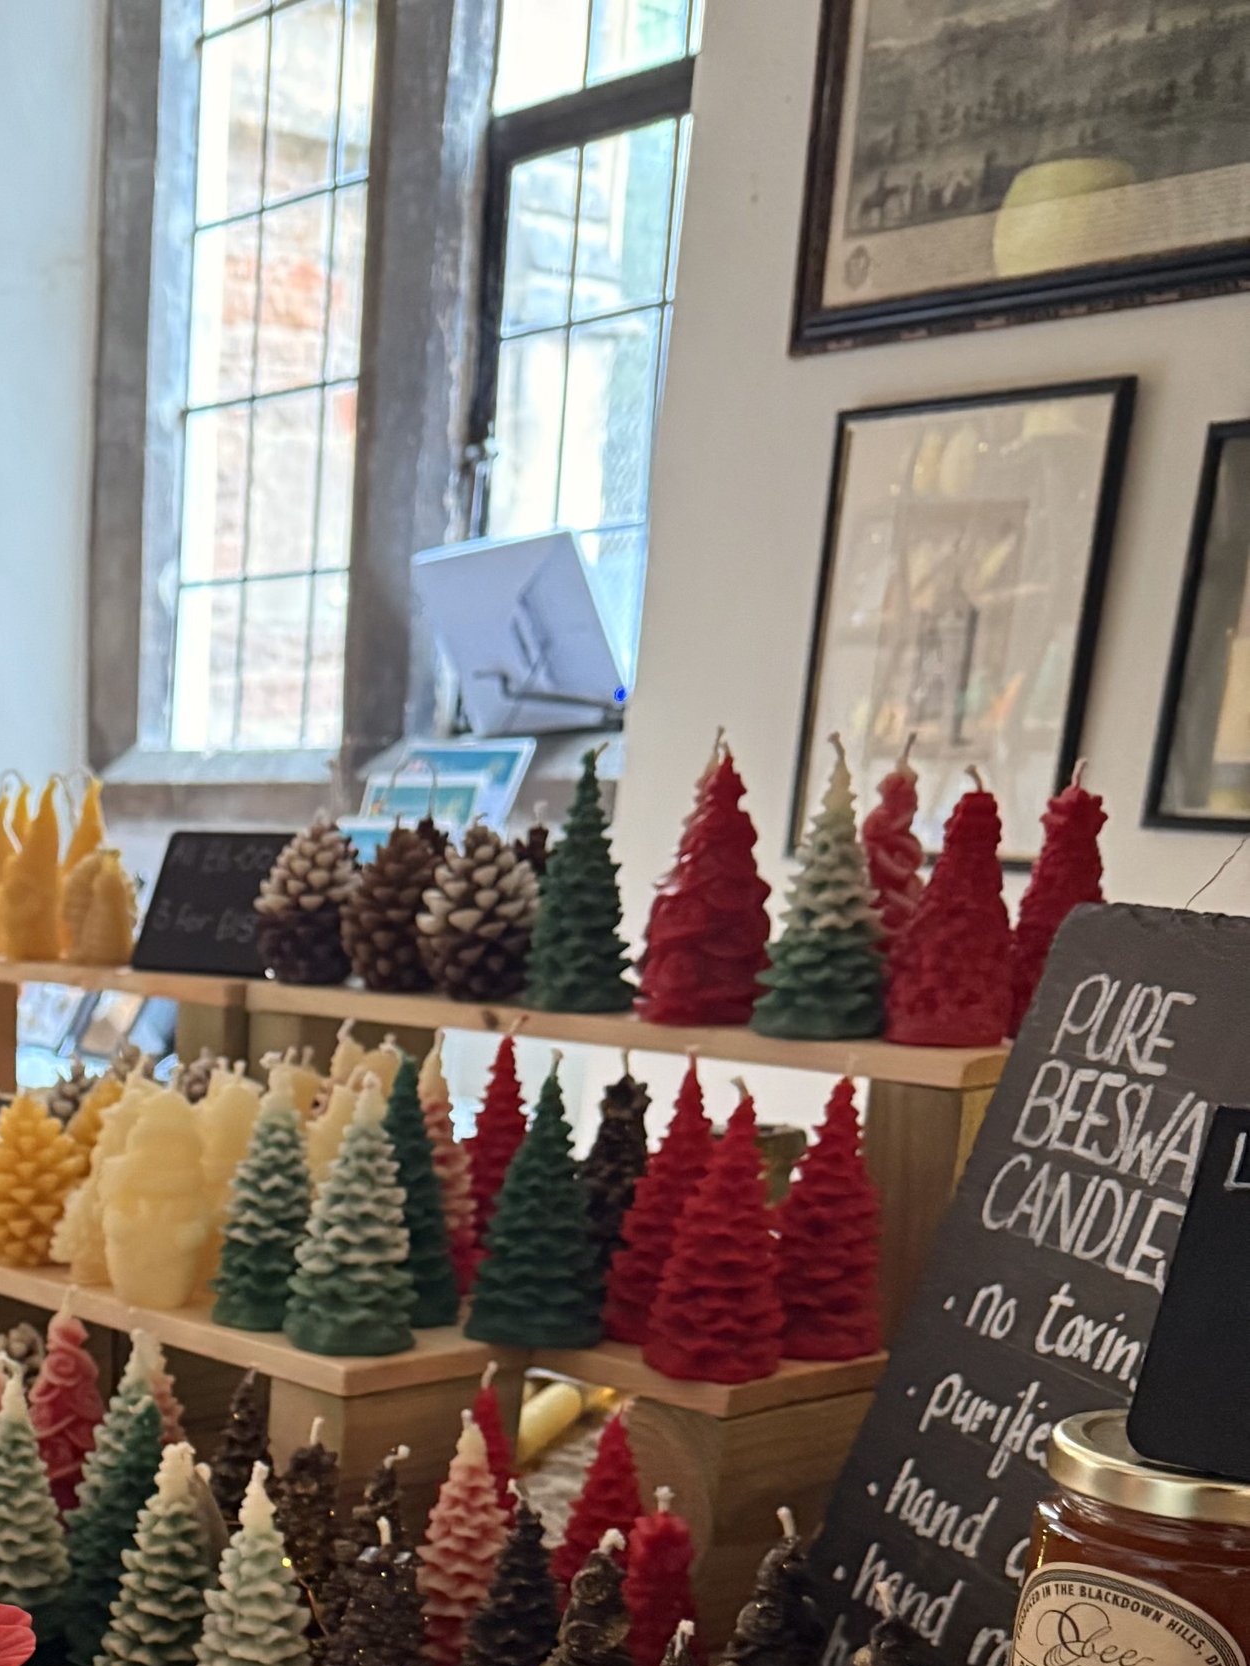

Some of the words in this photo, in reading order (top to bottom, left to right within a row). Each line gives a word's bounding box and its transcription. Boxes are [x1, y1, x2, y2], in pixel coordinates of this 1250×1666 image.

[1051, 972, 1197, 1077] PURE
[1013, 1059, 1208, 1197] BEESWA
[981, 1153, 1187, 1295] CANDLE
[964, 1283, 1016, 1341] no
[918, 1372, 1050, 1479] purifie
[884, 1457, 999, 1560] hand
[851, 1541, 964, 1647] hand
[1054, 1583, 1075, 1596] THE
[1079, 1585, 1163, 1624] BLACKDOWN
[1166, 1612, 1204, 1656] HILLS,
